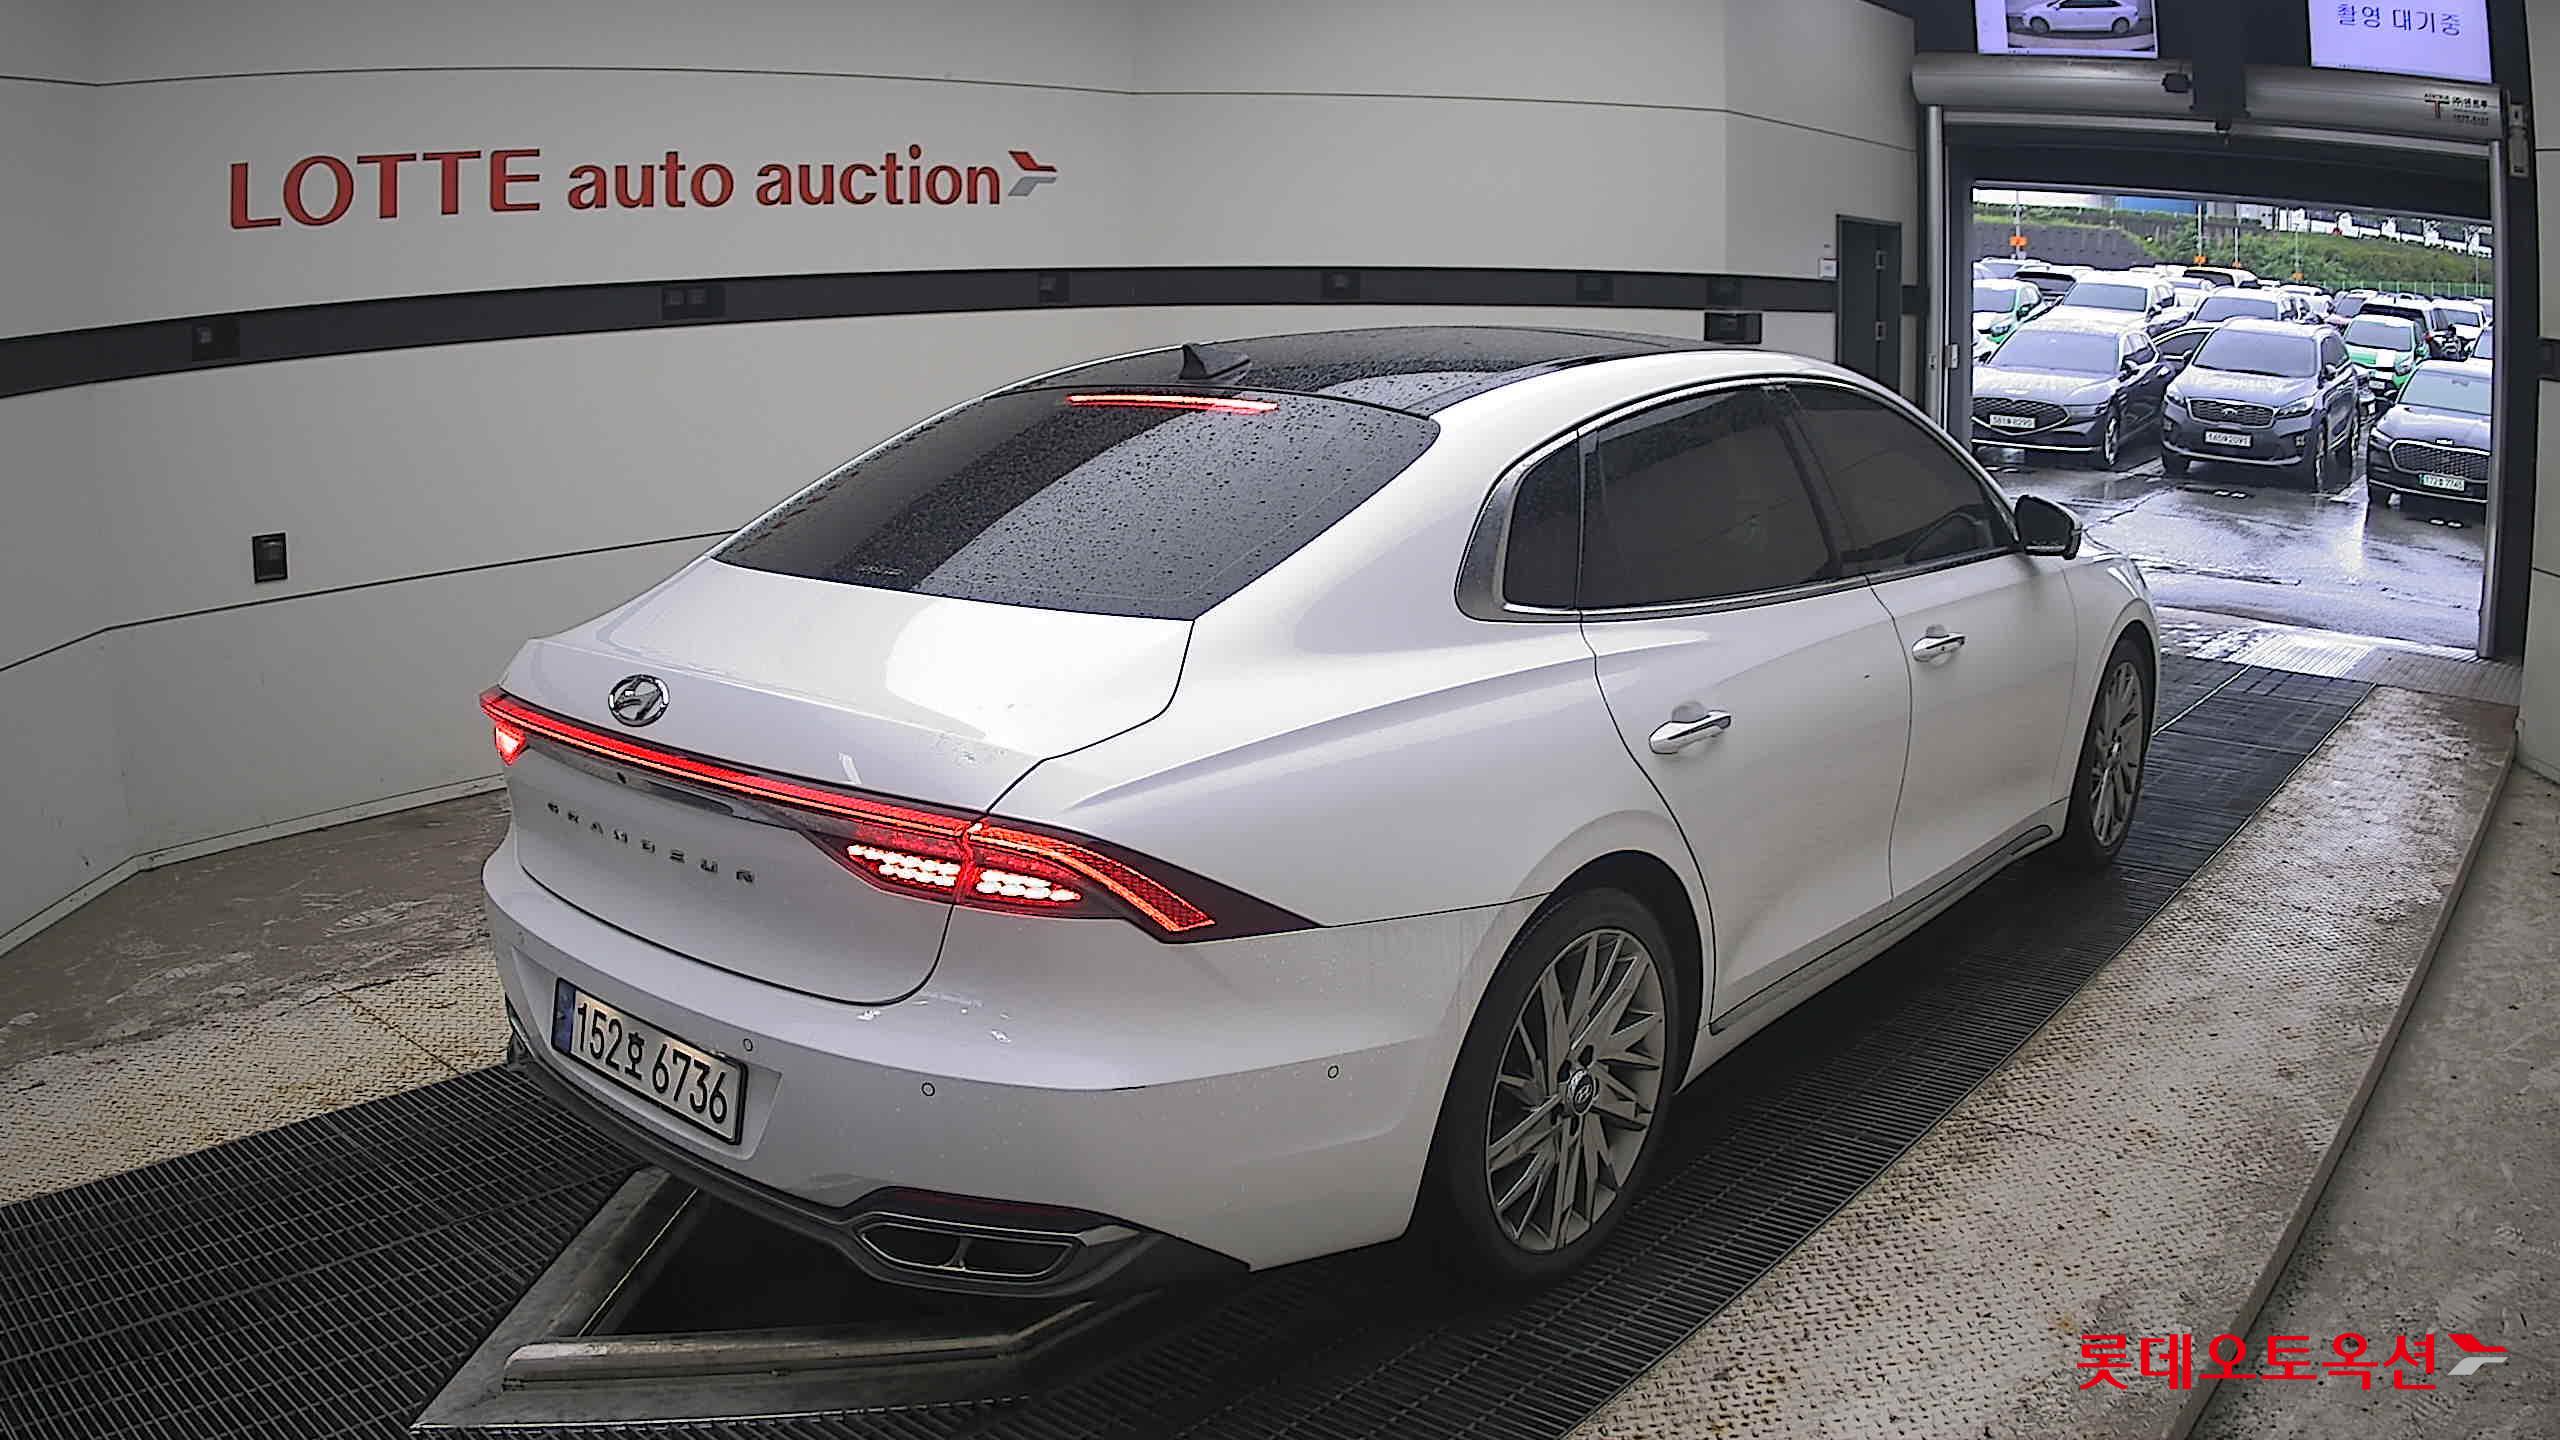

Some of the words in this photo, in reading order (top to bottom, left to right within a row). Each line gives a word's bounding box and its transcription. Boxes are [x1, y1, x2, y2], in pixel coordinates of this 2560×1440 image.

[2337, 4, 2382, 28] 촬영
[2392, 9, 2461, 36] 대기중
[230, 148, 541, 230] LOTTE
[567, 150, 735, 210] auto
[755, 144, 1001, 206] auction
[547, 801, 754, 884] GRANDEUR
[577, 1002, 645, 1081] 152호
[652, 1043, 728, 1124] 6736
